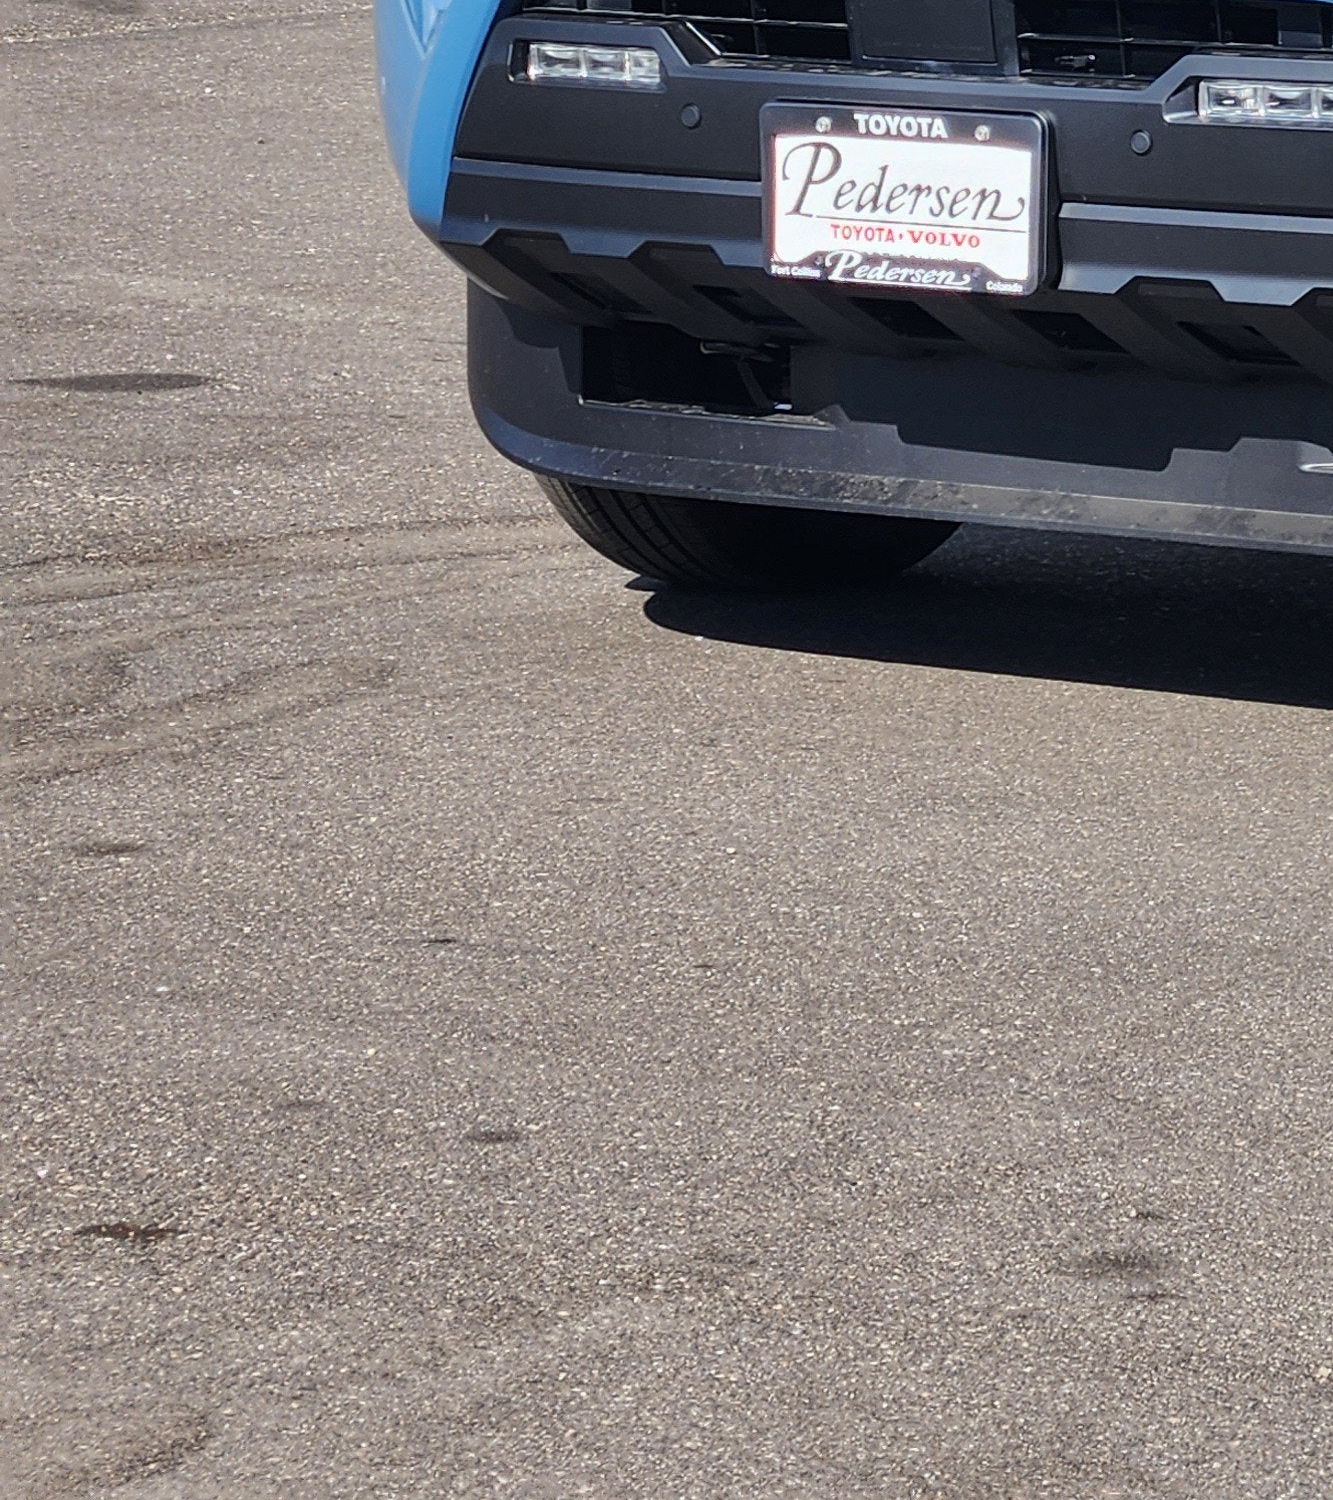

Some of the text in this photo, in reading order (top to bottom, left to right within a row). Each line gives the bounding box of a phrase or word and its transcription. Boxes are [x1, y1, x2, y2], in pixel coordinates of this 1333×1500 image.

[853, 113, 948, 139] TOYOTA
[782, 141, 1026, 222] Pedersen
[830, 224, 981, 248] TOYOTA VOLVO
[824, 250, 971, 286] Pedersen
